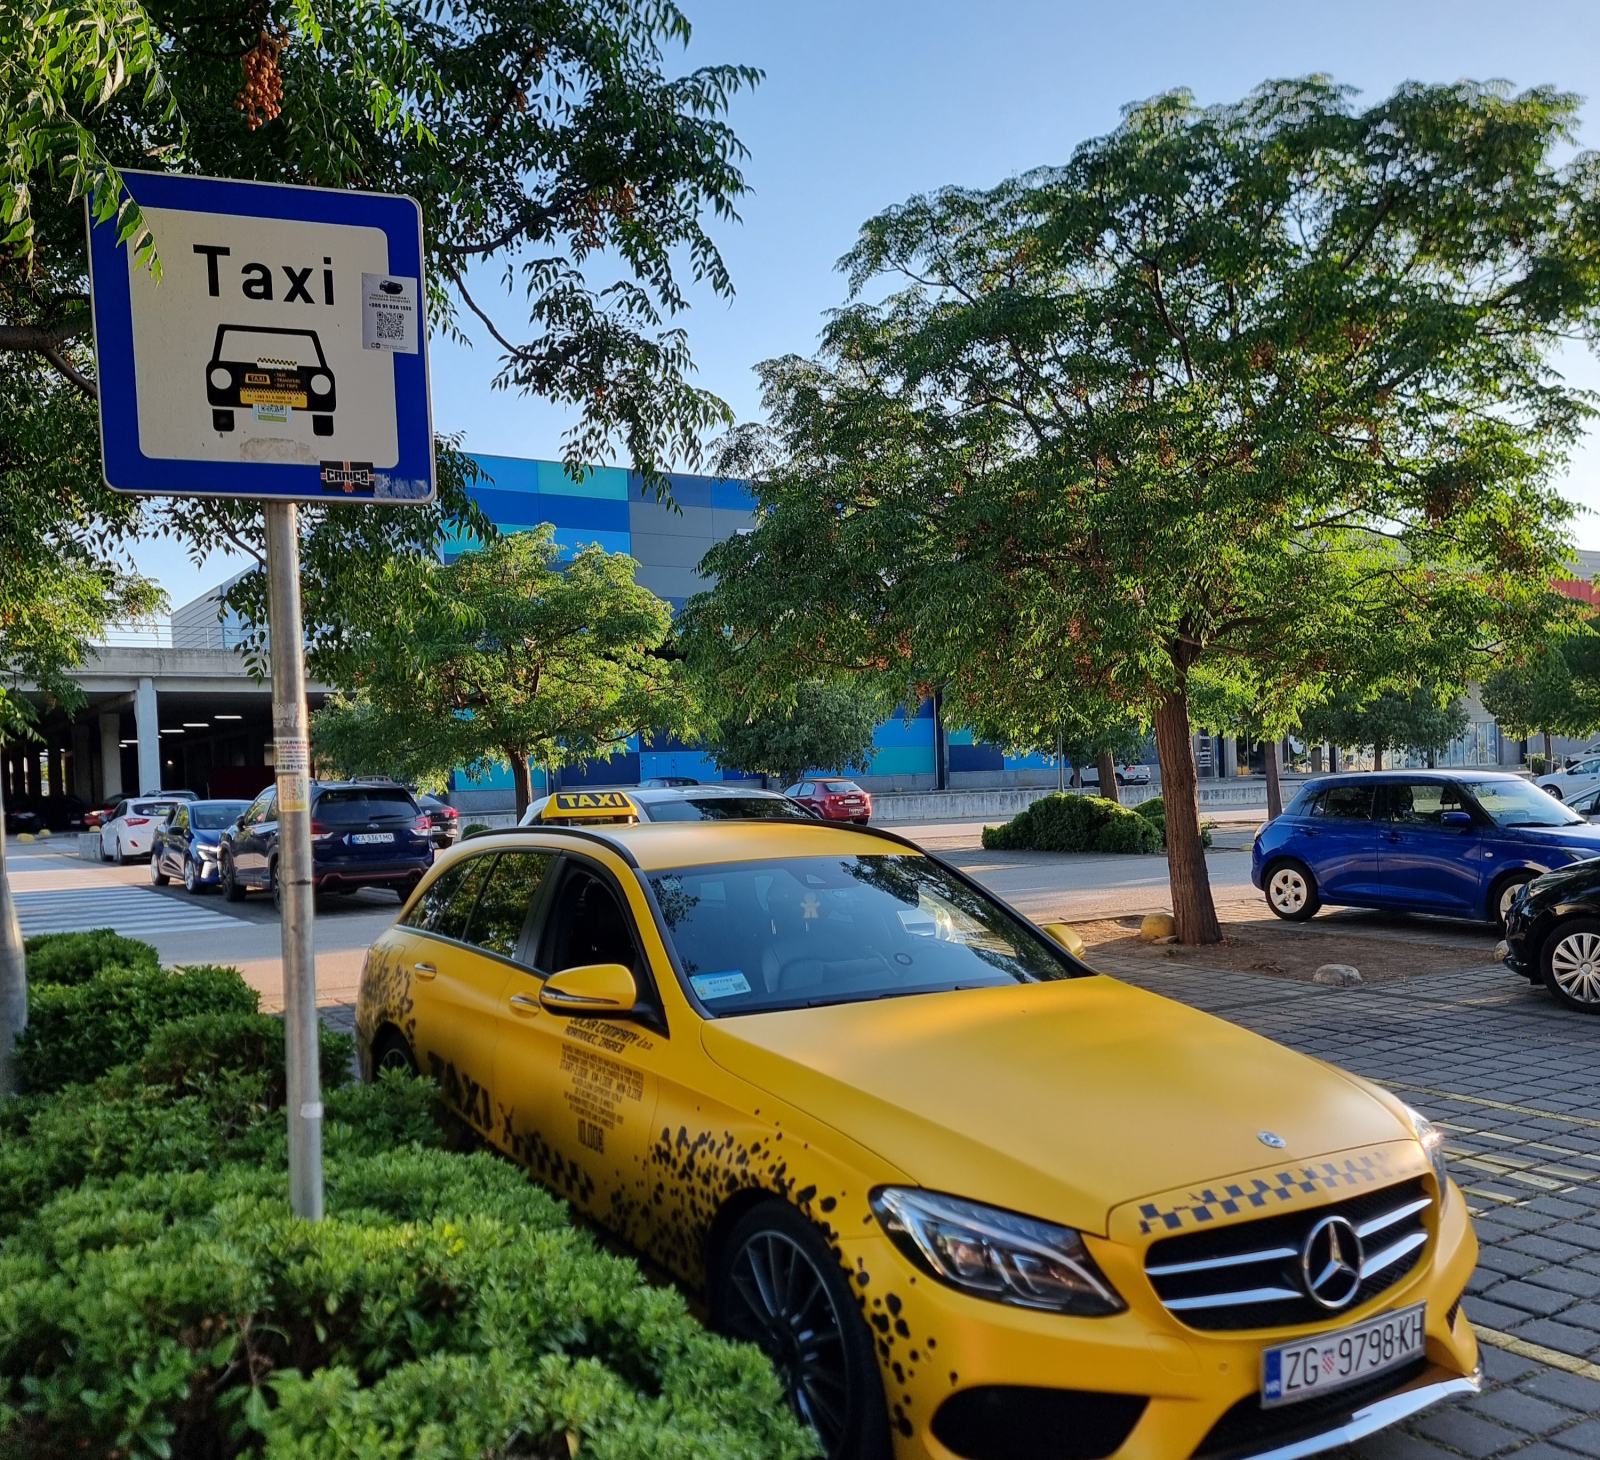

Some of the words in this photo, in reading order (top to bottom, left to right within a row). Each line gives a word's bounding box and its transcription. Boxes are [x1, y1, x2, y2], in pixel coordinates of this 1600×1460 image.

[193, 244, 334, 305] Taxi
[560, 793, 624, 807] TAXI
[595, 1021, 640, 1042] COMPANY
[1286, 1347, 1318, 1390] ZG
